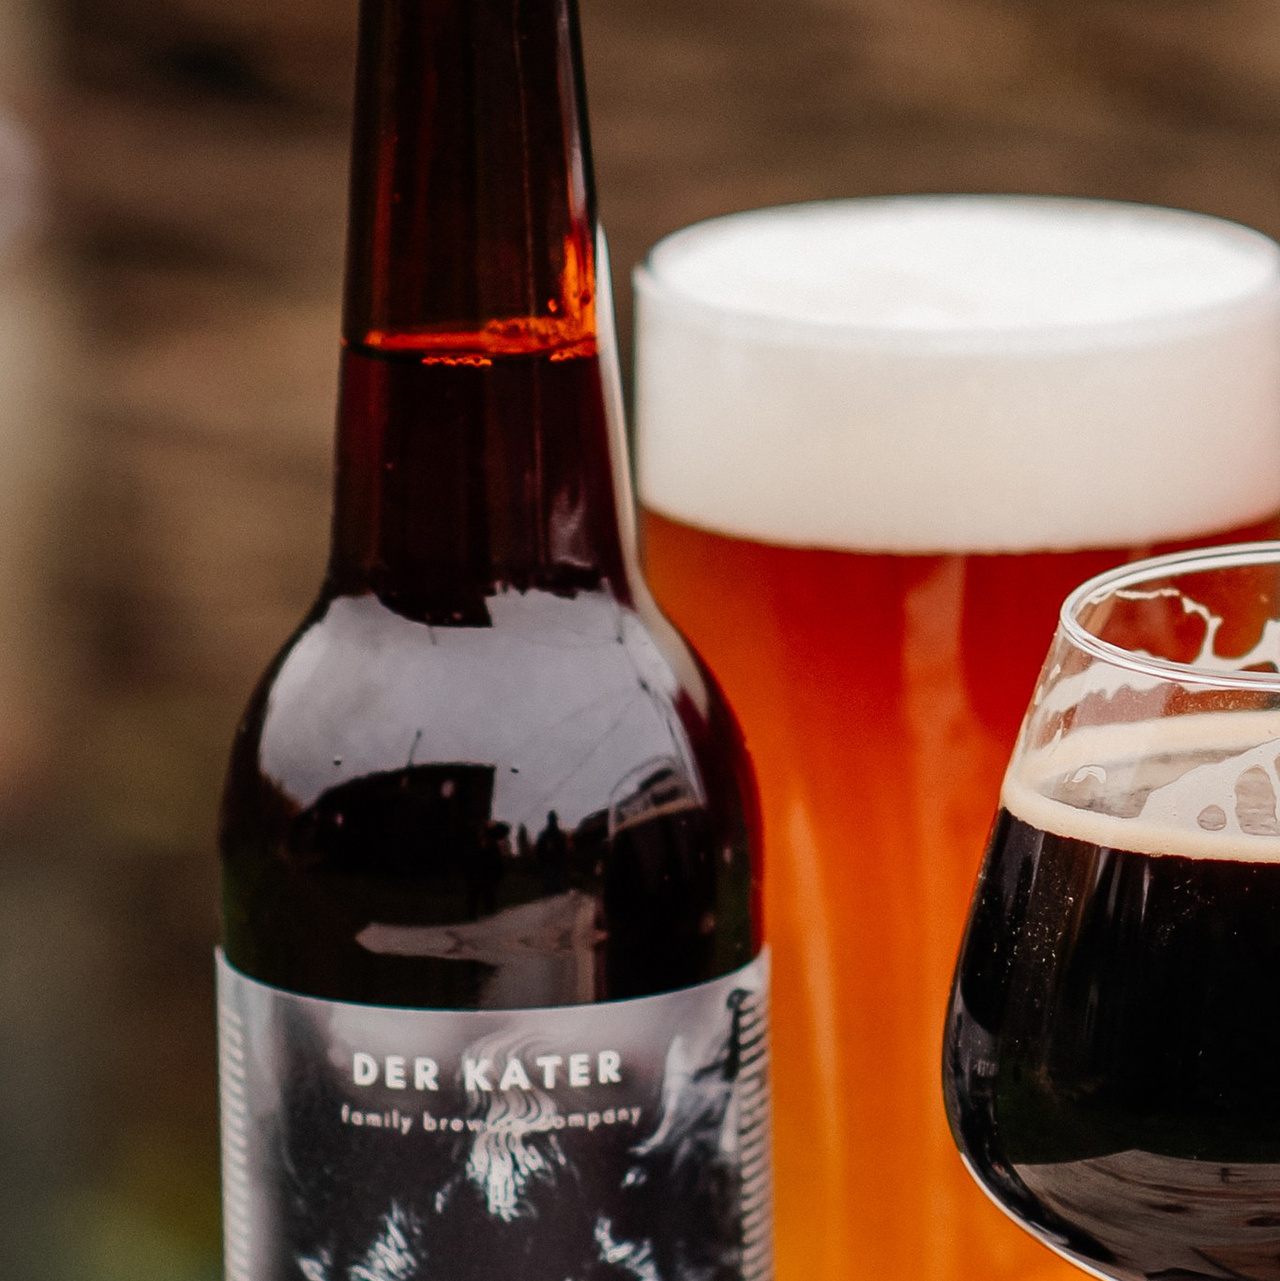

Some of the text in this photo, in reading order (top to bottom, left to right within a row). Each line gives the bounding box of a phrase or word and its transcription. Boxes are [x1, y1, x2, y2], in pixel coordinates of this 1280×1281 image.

[353, 1050, 622, 1092] DER KATER
[341, 1103, 413, 1134] family
